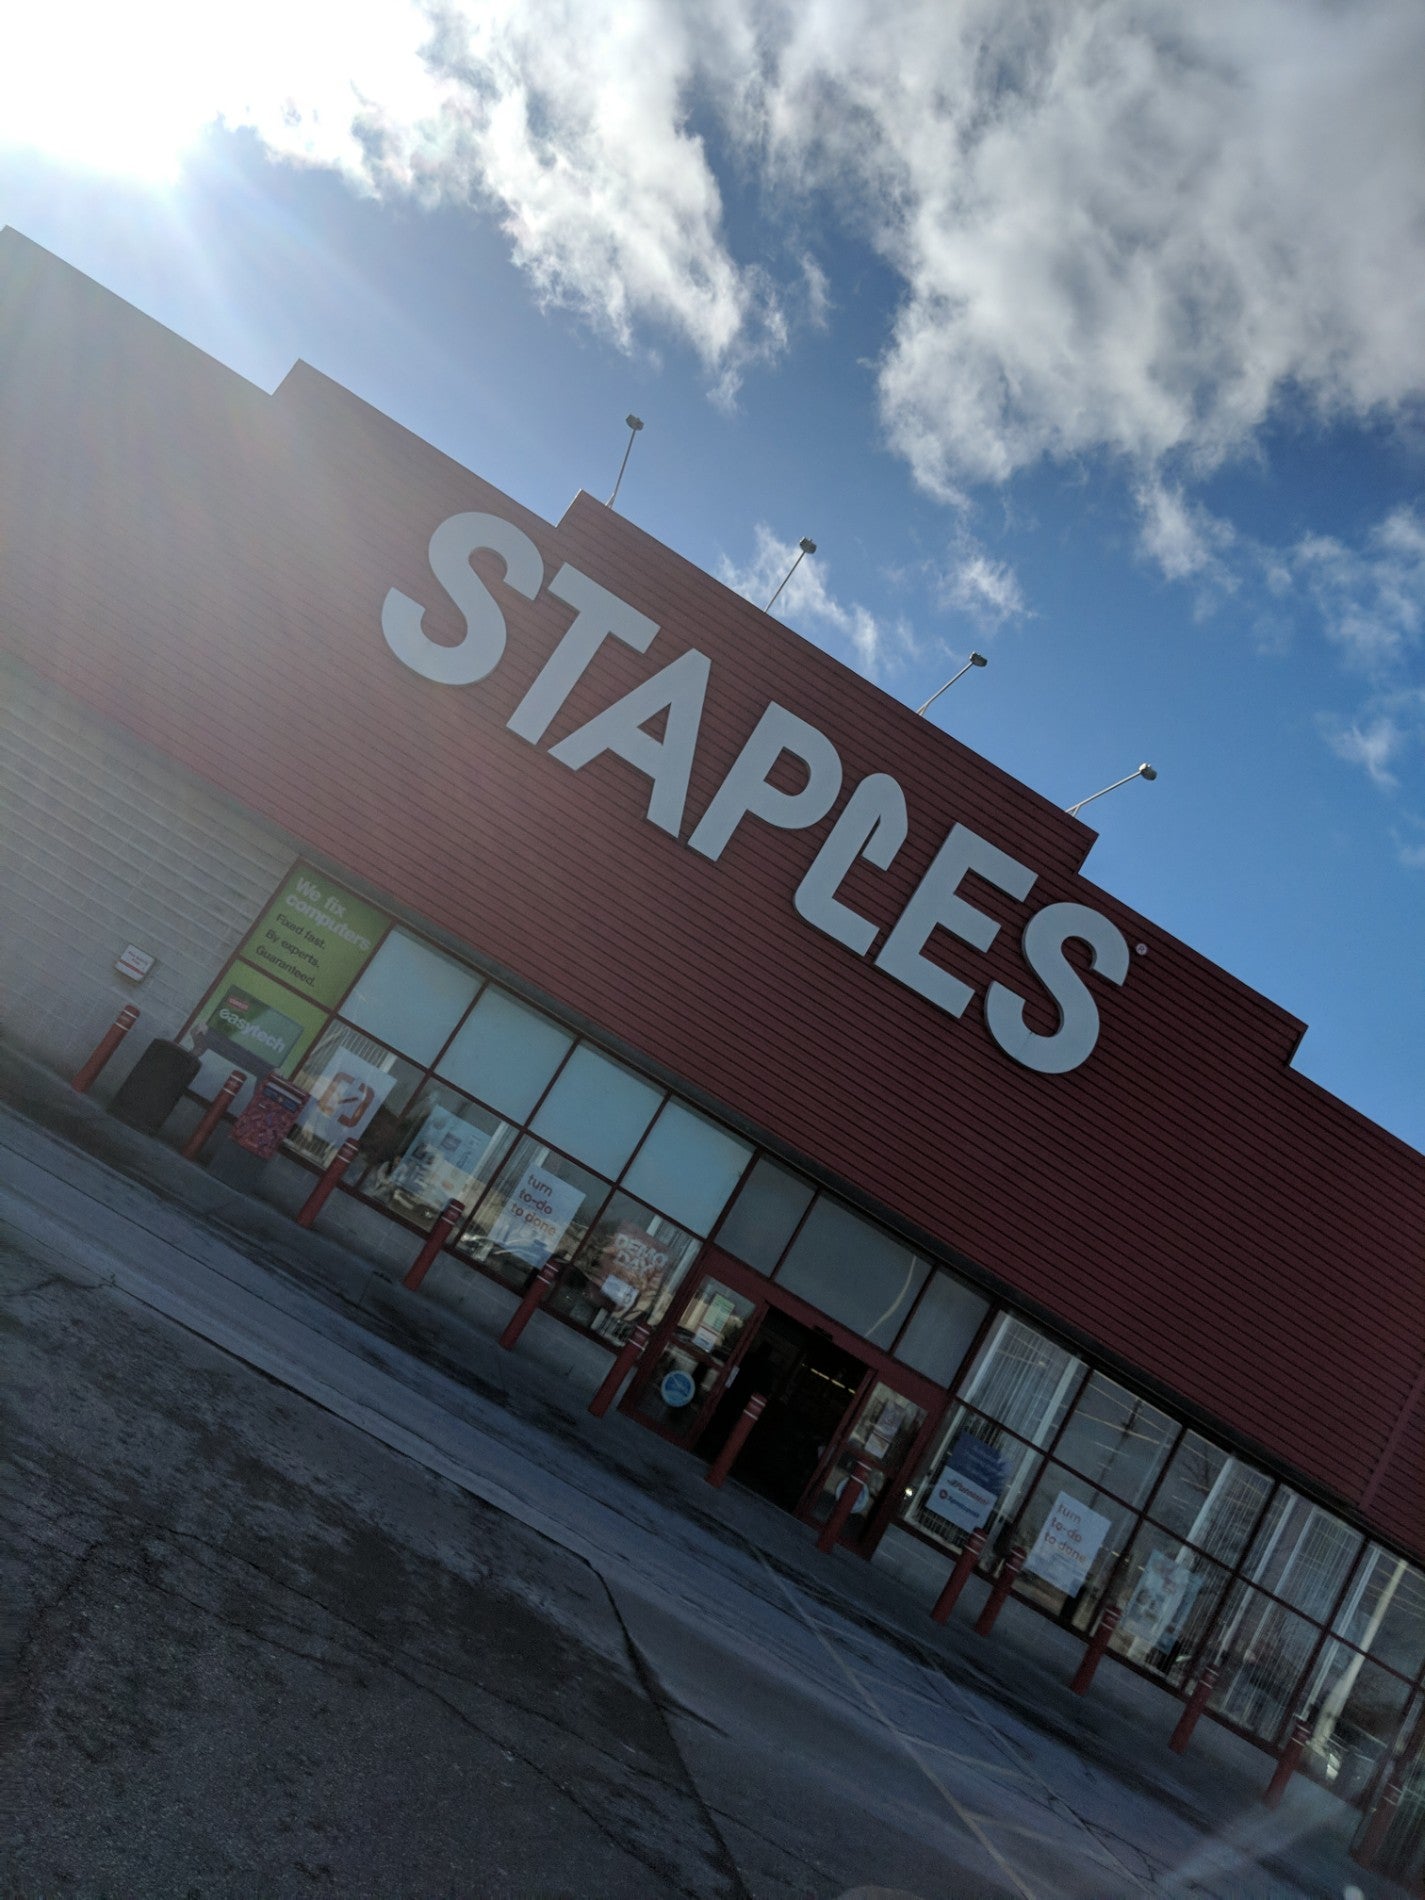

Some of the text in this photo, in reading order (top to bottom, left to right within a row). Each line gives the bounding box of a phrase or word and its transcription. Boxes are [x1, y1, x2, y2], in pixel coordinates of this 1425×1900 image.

[382, 511, 1130, 1074] STAPLES
[296, 877, 347, 917] We fix
[265, 929, 320, 968] By experts.
[276, 913, 325, 950] Fixed fast.
[256, 945, 315, 987] Guaranteed.
[220, 1008, 285, 1053] easytech
[519, 1188, 553, 1215] to-do
[528, 1174, 553, 1197] turn
[511, 1203, 556, 1236] to done
[1051, 1517, 1082, 1543] to-do
[1058, 1503, 1082, 1524] turn
[1044, 1531, 1087, 1562] to done
